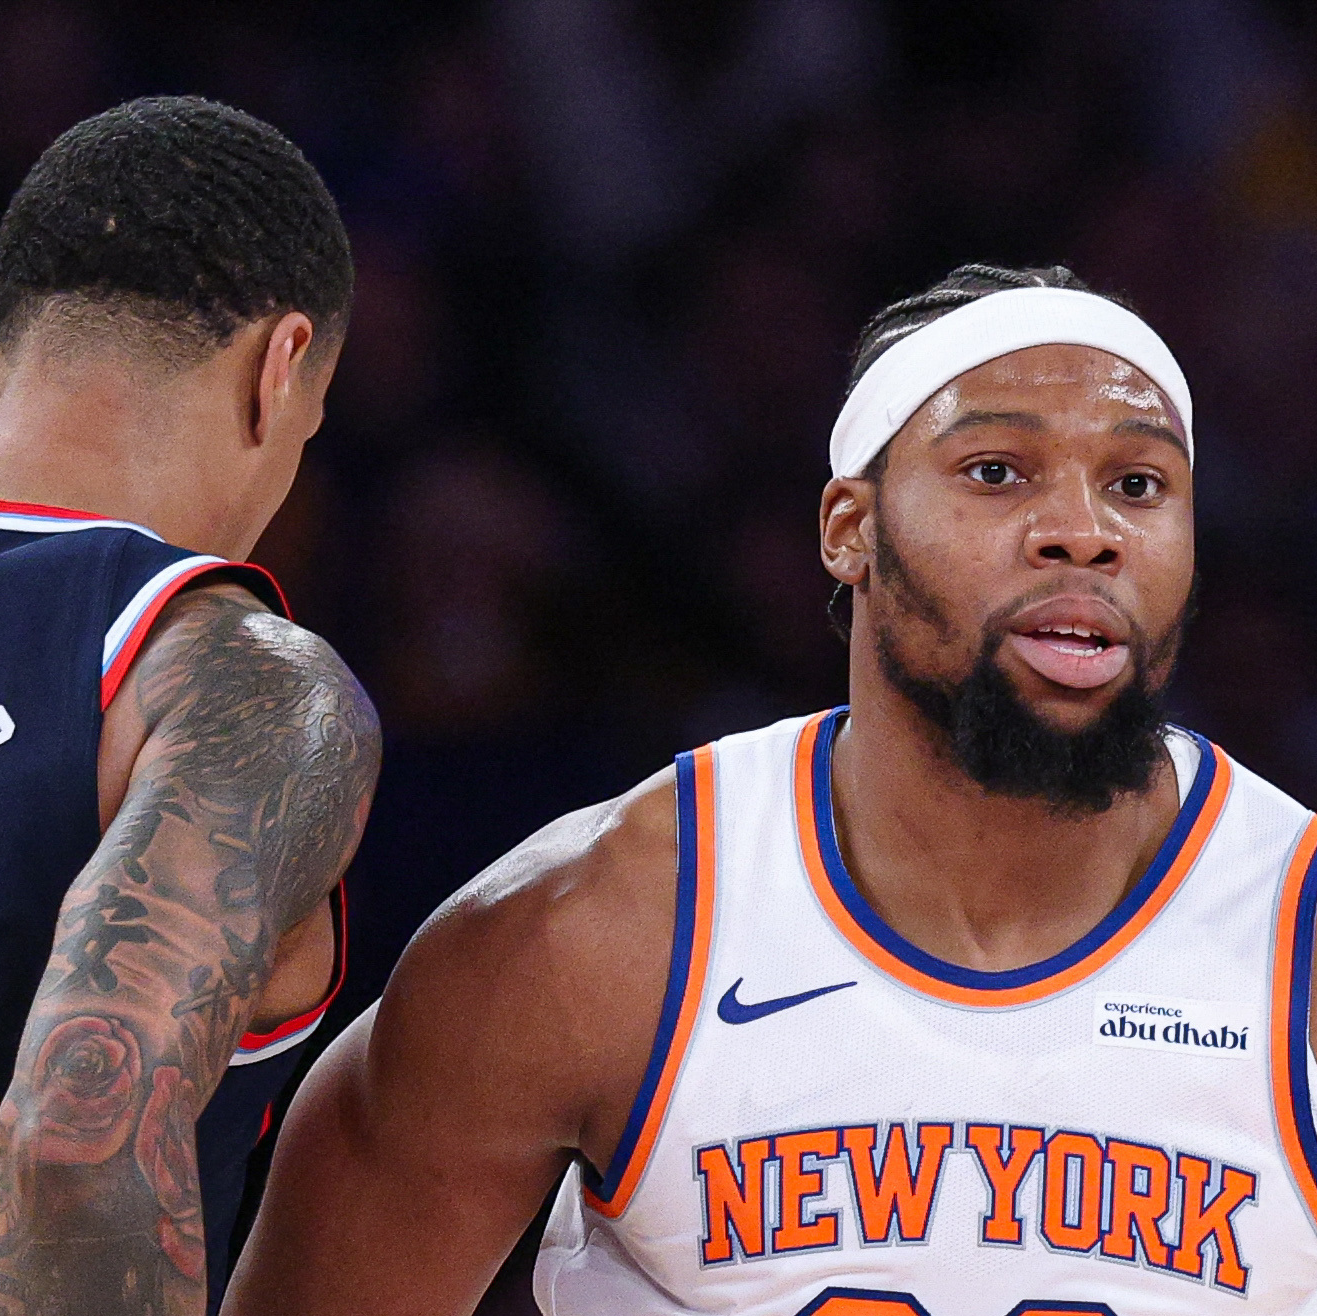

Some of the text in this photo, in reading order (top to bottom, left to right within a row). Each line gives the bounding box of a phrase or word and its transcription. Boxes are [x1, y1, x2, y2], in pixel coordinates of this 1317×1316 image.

[1104, 1002, 1182, 1017] experience
[1099, 1016, 1157, 1041] abu
[694, 1120, 1259, 1299] NEW YORK
